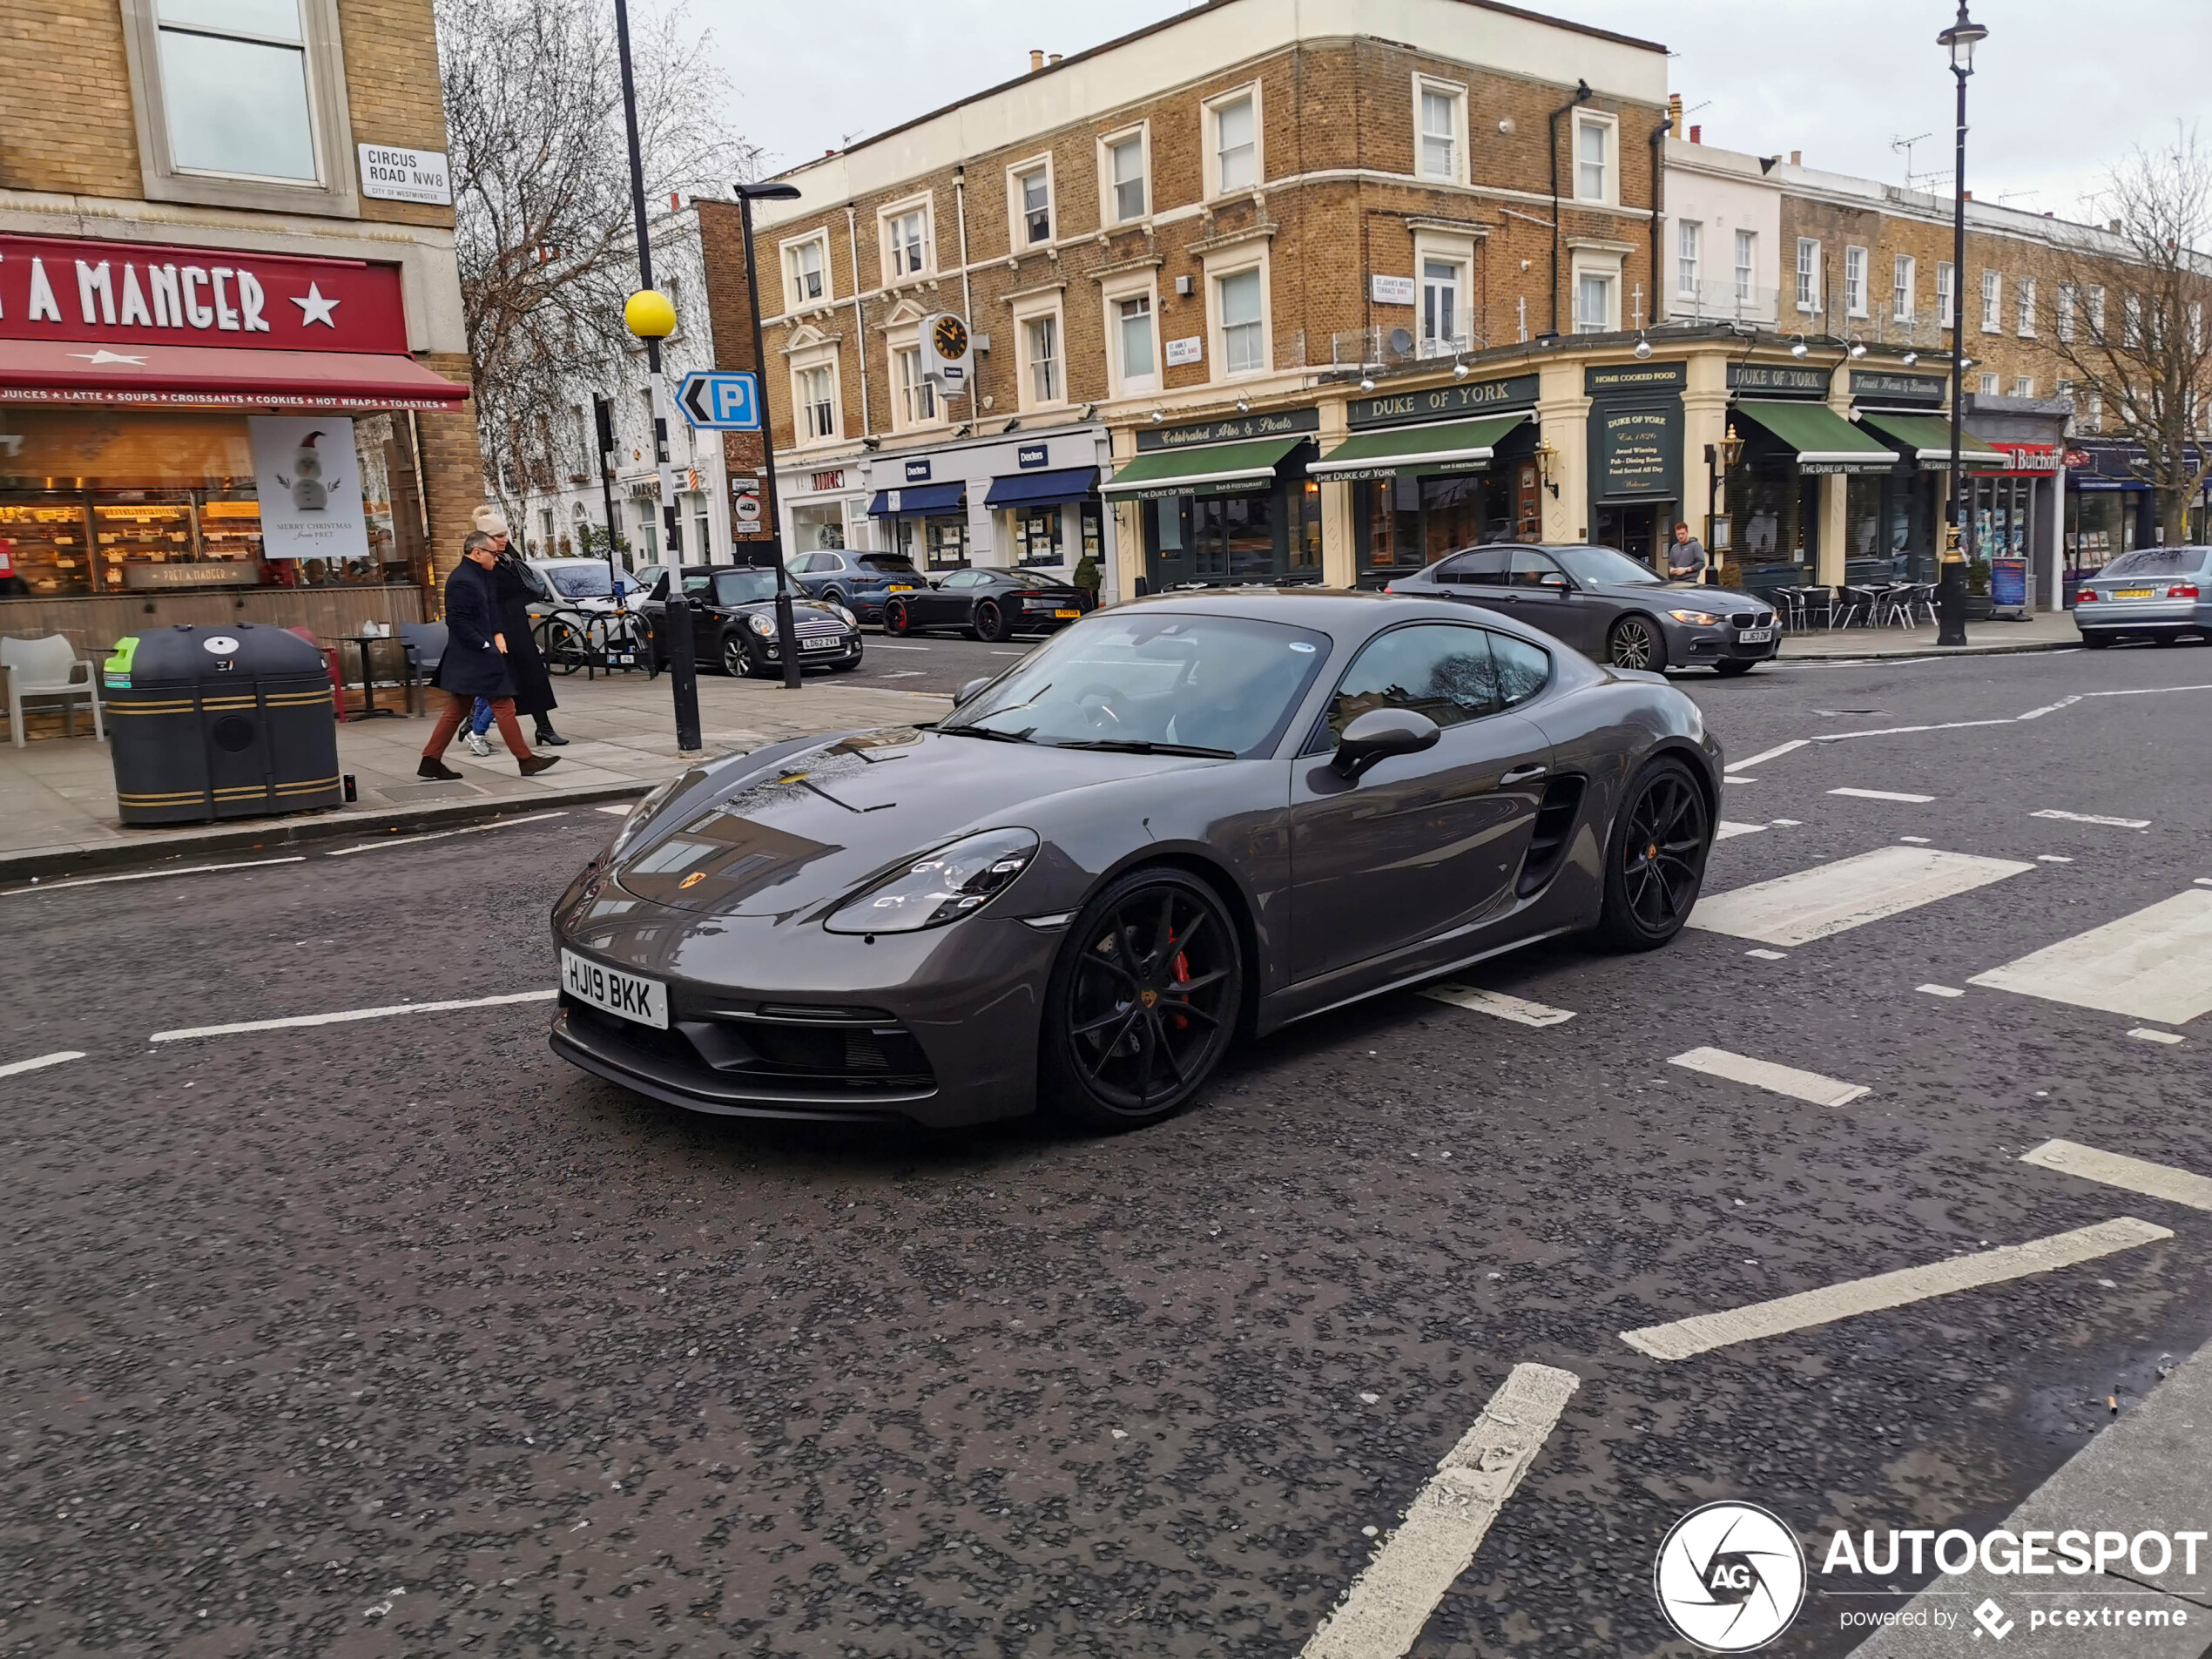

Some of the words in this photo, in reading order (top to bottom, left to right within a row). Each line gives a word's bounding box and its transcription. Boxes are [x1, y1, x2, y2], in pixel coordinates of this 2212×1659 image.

[368, 150, 417, 168] CIRCUS
[370, 166, 406, 183] ROAD
[414, 172, 443, 187] NW8
[396, 190, 438, 200] WESTMINSTER
[29, 255, 62, 322] A
[75, 259, 270, 333] MANGER
[1595, 374, 1619, 384] HOME
[1620, 373, 1653, 382] COOKED
[1654, 371, 1676, 380] FOOD
[1735, 368, 1767, 385] DUKE
[1772, 370, 1784, 386] OF
[1790, 371, 1818, 387] YORK
[1, 389, 48, 399] JUICES
[64, 391, 104, 401] LATTE
[117, 393, 158, 401] SOUPS
[171, 394, 244, 403] CROISSANTS
[256, 395, 304, 405] COOKIES
[316, 397, 337, 406] HOT
[341, 398, 378, 407] WRAPS
[389, 400, 439, 408] TOASTIES
[718, 382, 745, 419] P
[1372, 396, 1414, 417] DUKE
[1429, 391, 1449, 409] OF
[1460, 382, 1509, 405] YORK
[1608, 416, 1631, 428] DUKE
[1631, 415, 1642, 424] OF
[1643, 415, 1666, 426] YORK
[1162, 427, 1210, 445] Celebrated
[1216, 422, 1239, 438] Ales
[1244, 421, 1253, 435] &
[1258, 416, 1292, 432] Stouts
[1021, 451, 1043, 462] Dexters
[1633, 446, 1657, 455] Winning
[907, 465, 927, 476] Dexters
[1315, 473, 1332, 482] THE
[1332, 471, 1359, 482] DUKE
[1359, 470, 1370, 479] OF
[1372, 468, 1397, 478] YORK
[1802, 464, 1815, 474] THE
[1816, 464, 1834, 474] DUKE
[1835, 464, 1843, 473] OF
[1844, 464, 1861, 474] YORK
[1150, 489, 1167, 498] DUKE
[293, 531, 314, 541] from
[163, 570, 182, 581] PRET
[193, 568, 226, 581] MANGER
[805, 638, 824, 648] LD62
[825, 637, 838, 646] ZVA
[569, 956, 604, 1002] HJ19
[609, 973, 651, 1018] BKK
